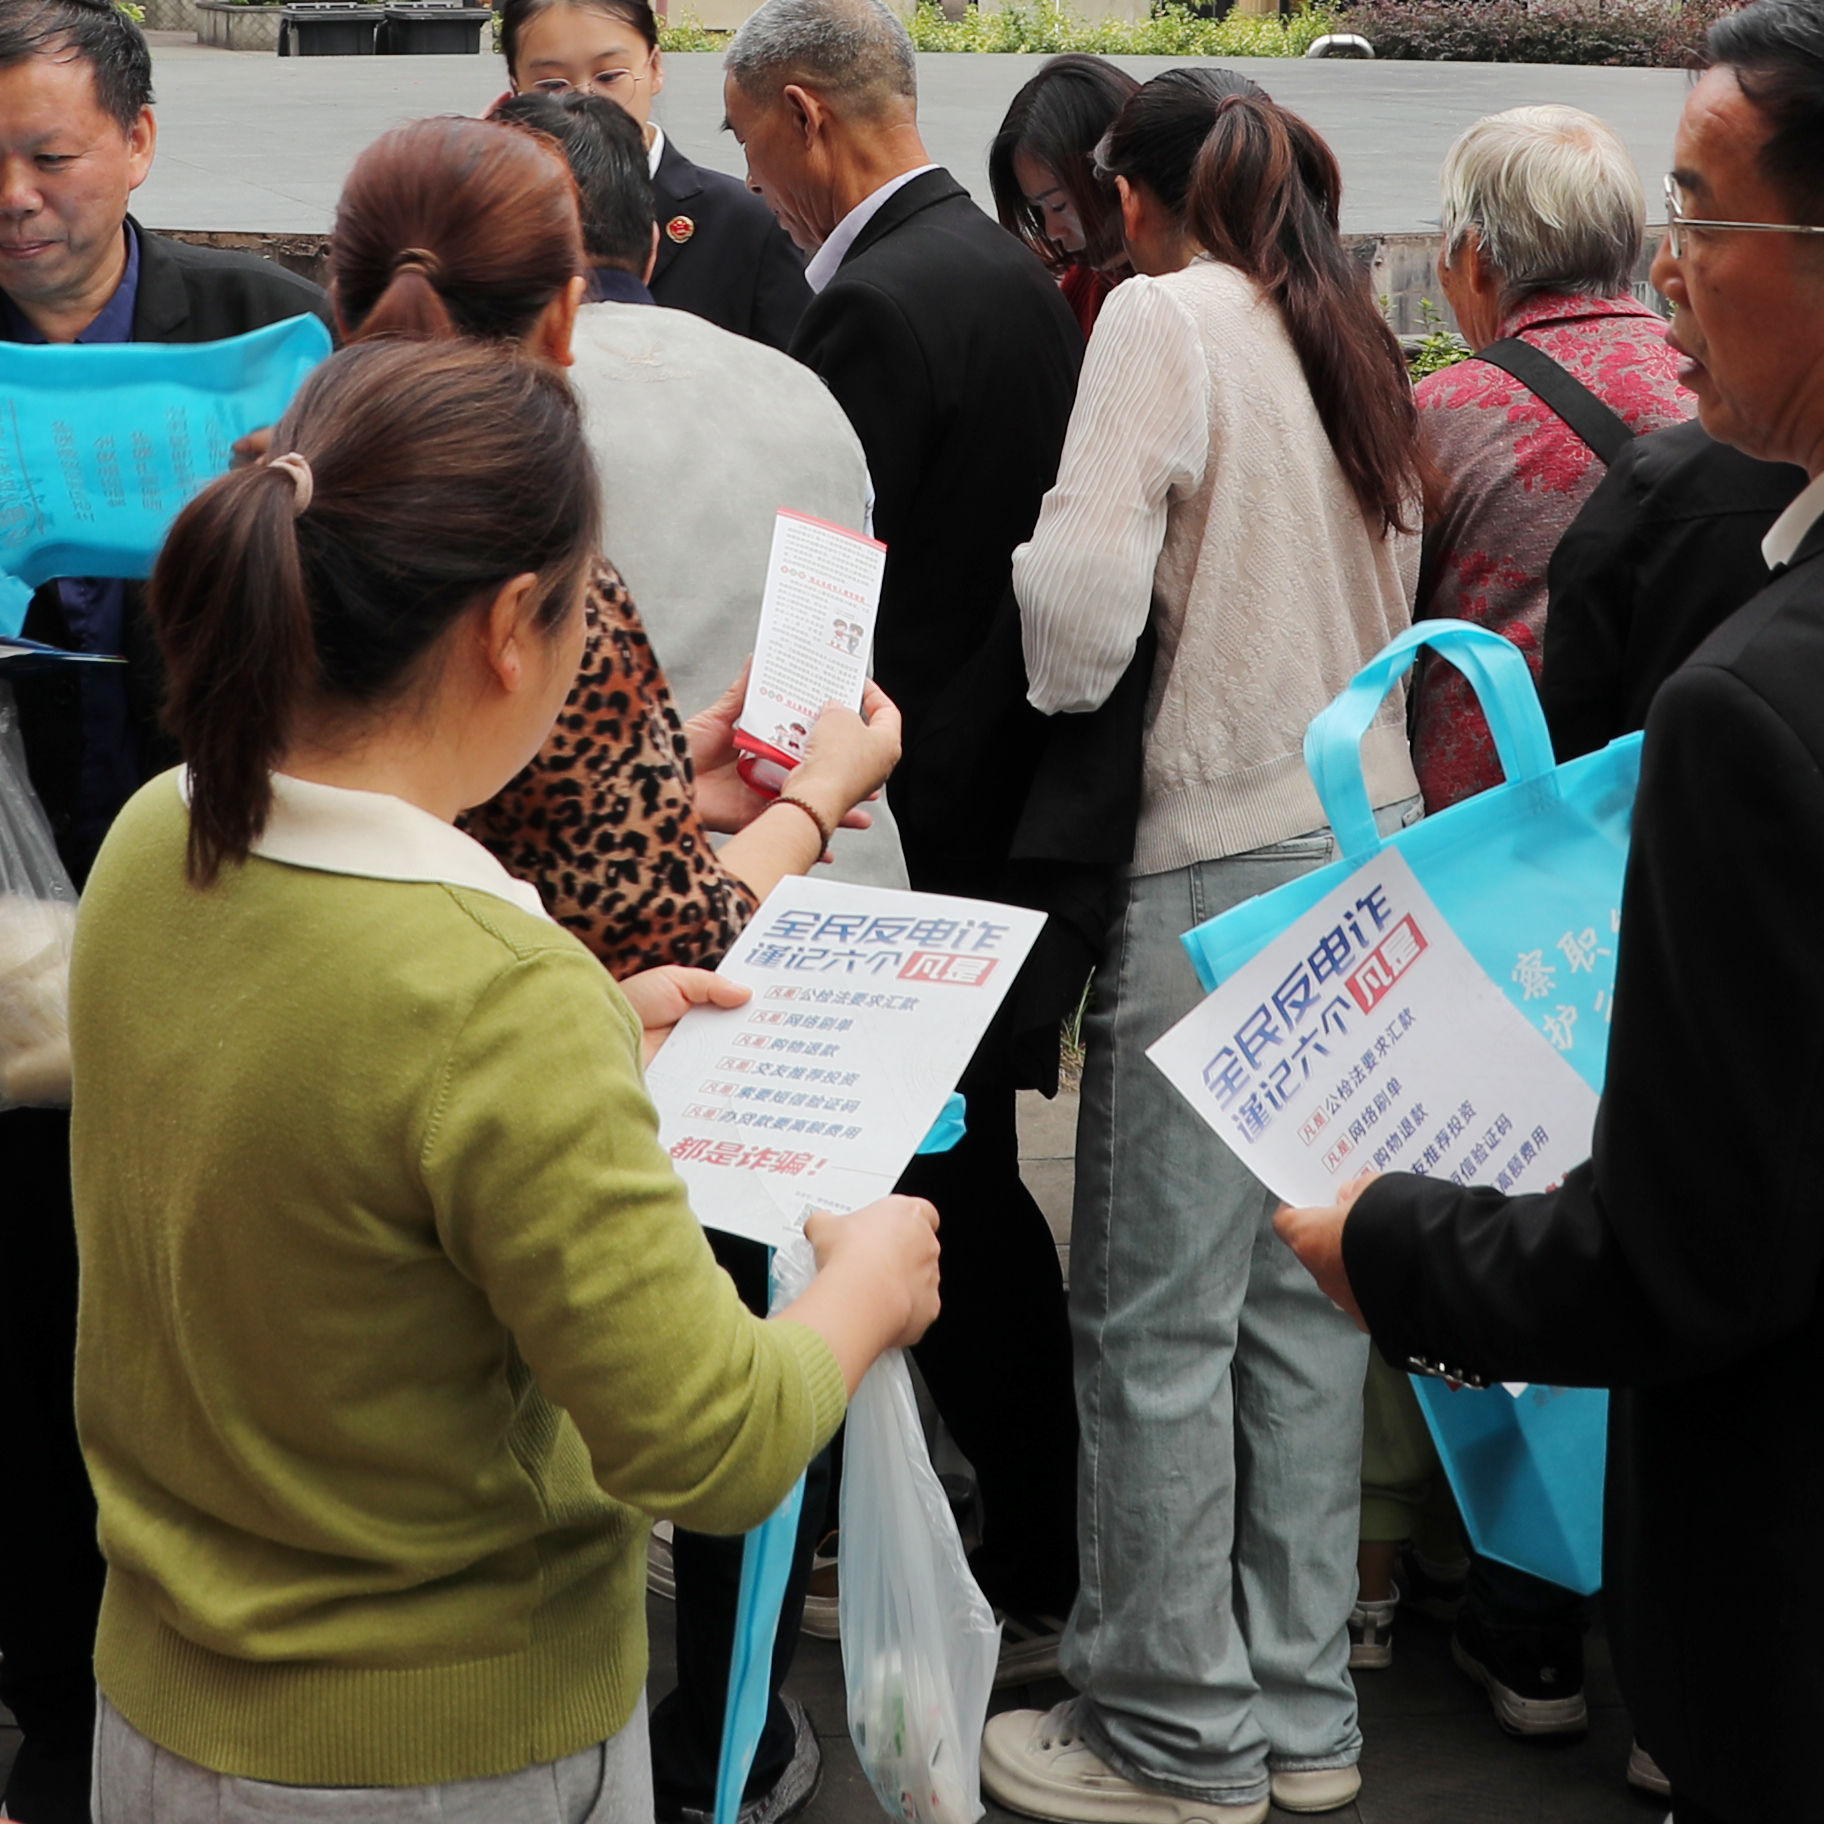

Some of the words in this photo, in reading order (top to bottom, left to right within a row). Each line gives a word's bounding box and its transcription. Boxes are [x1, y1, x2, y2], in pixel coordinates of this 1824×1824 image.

[764, 910, 1010, 950] 全民反电诈
[784, 1013, 854, 1032] 网络刷单
[1202, 884, 1392, 1110] 全民反电诈
[768, 1037, 840, 1058] 购物退款
[1326, 1007, 1417, 1116] 公检法要求汇款
[1348, 1077, 1403, 1144] 网络刷单
[1373, 1102, 1430, 1171] 购物退款
[670, 1136, 828, 1176] 都是诈骗！
[1491, 1124, 1550, 1194] 高额费用
